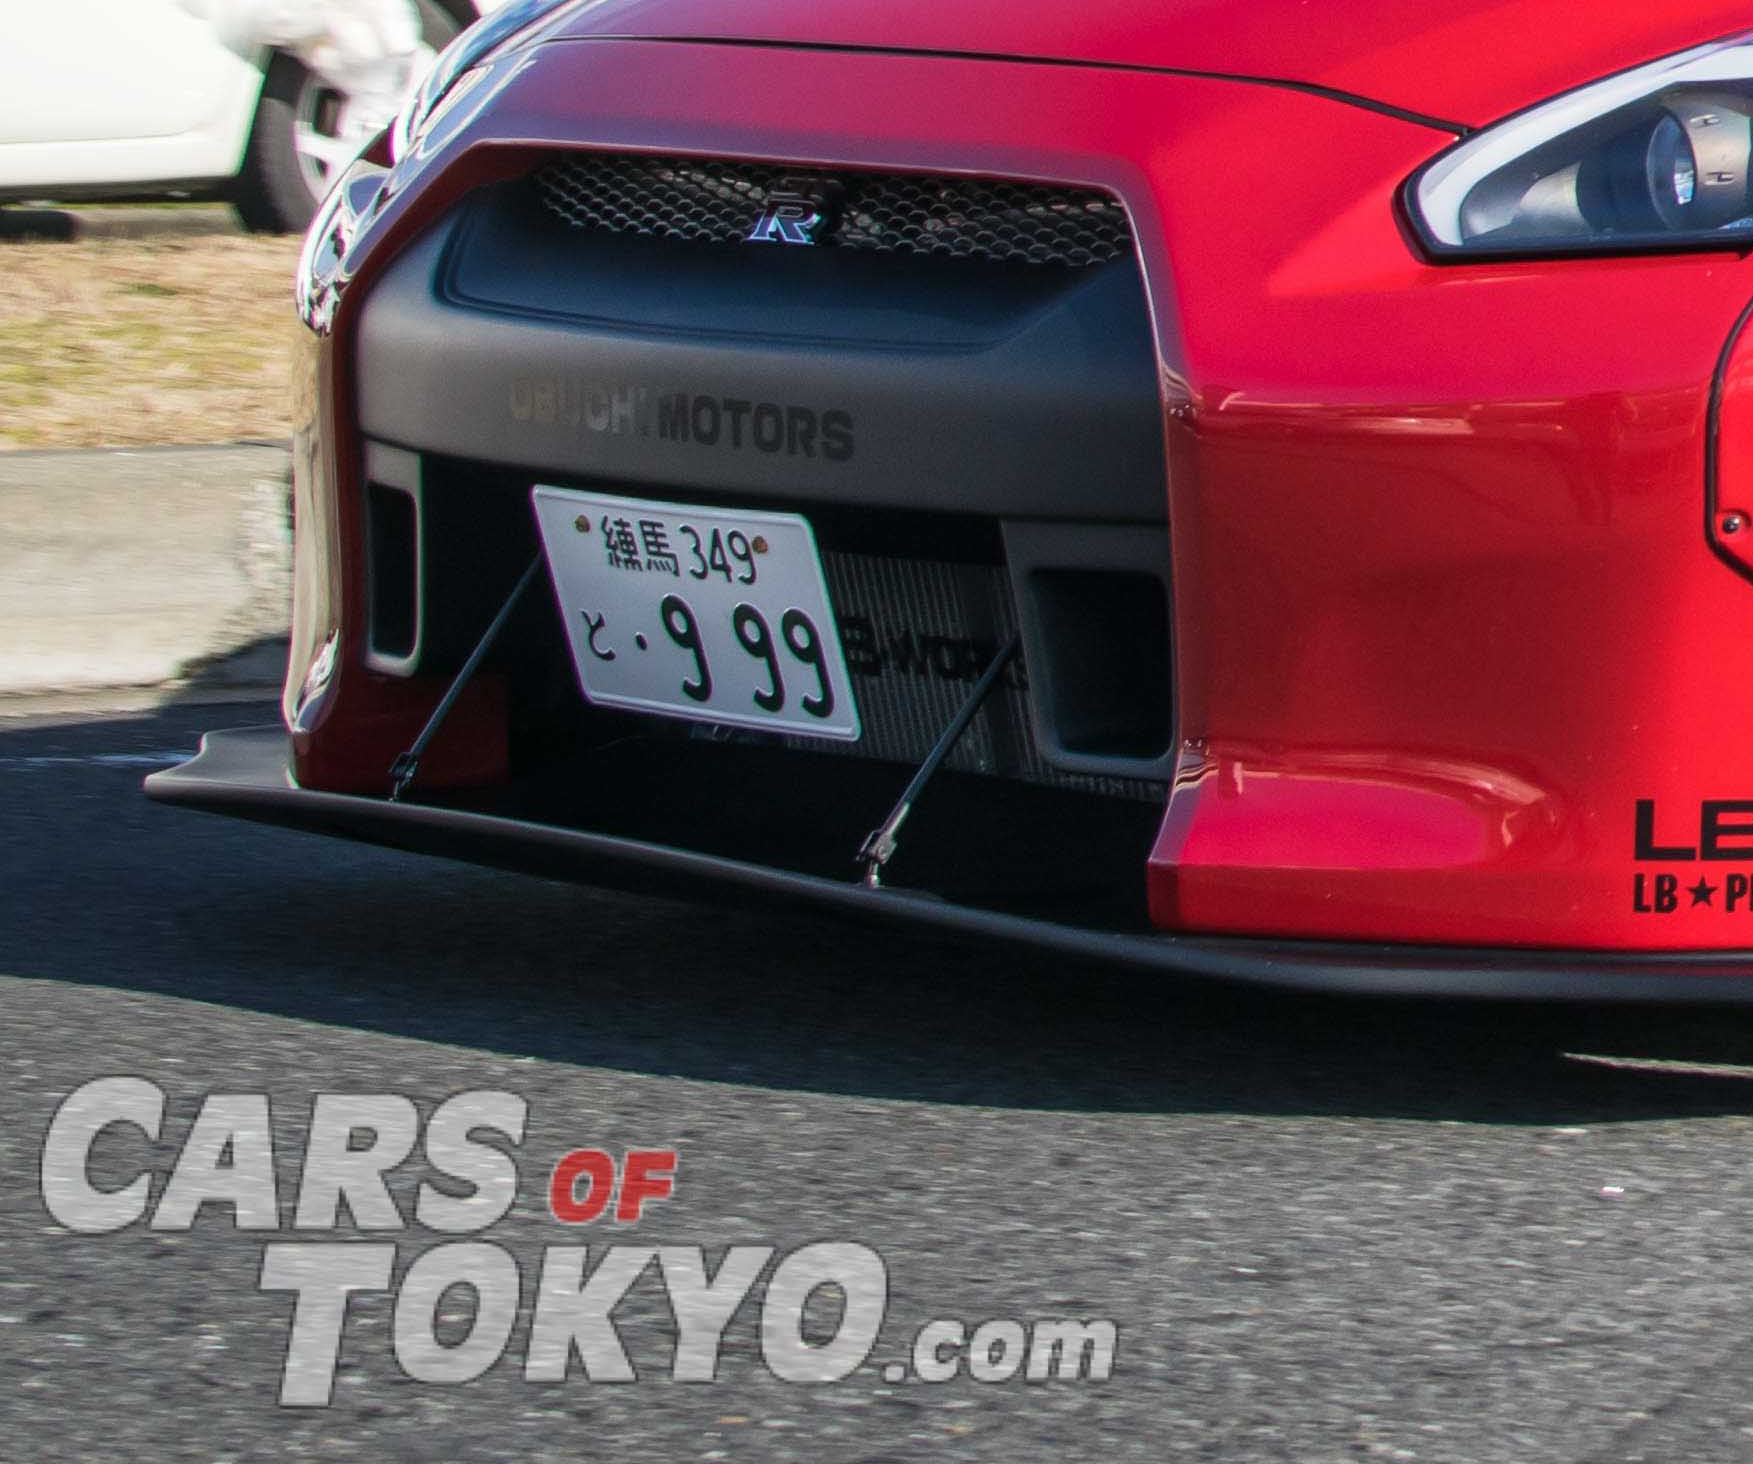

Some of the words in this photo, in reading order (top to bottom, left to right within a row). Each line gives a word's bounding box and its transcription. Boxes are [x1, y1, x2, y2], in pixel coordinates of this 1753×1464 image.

[657, 392, 854, 462] MOTORS
[601, 515, 680, 577] 練馬
[679, 524, 758, 585] 349
[580, 608, 616, 662] と
[1633, 873, 1679, 914] LB
